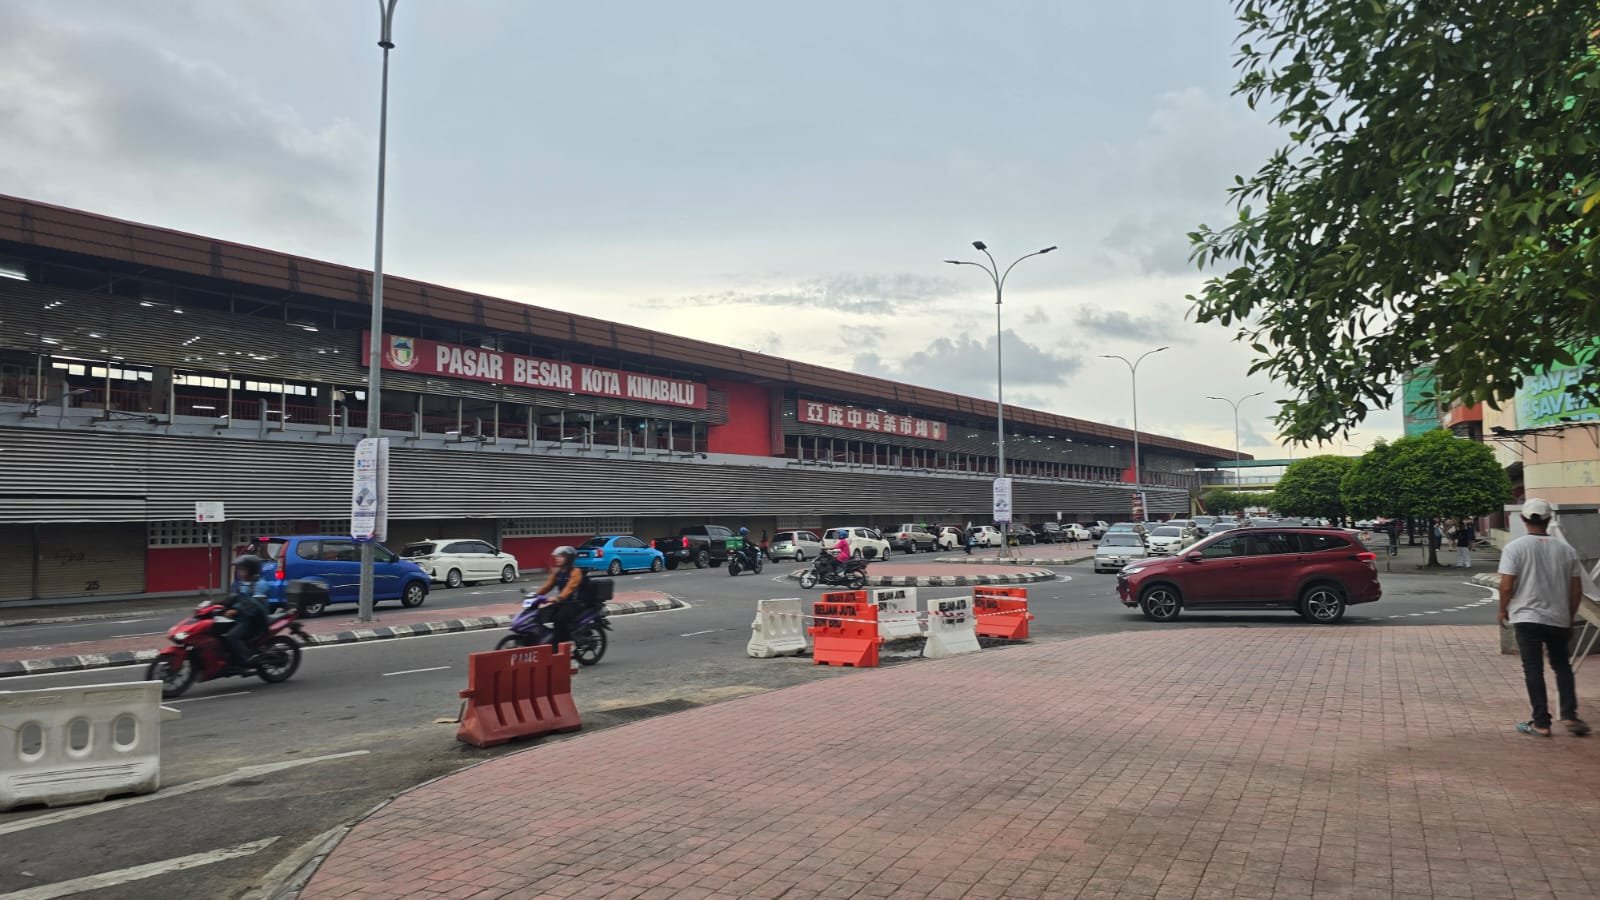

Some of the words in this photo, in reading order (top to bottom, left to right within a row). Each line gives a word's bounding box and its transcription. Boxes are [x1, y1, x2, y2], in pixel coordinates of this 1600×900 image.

[436, 345, 503, 380] PASAR
[513, 357, 573, 389] BESAR
[581, 367, 621, 396] KOTA
[626, 375, 695, 405] KINABALU
